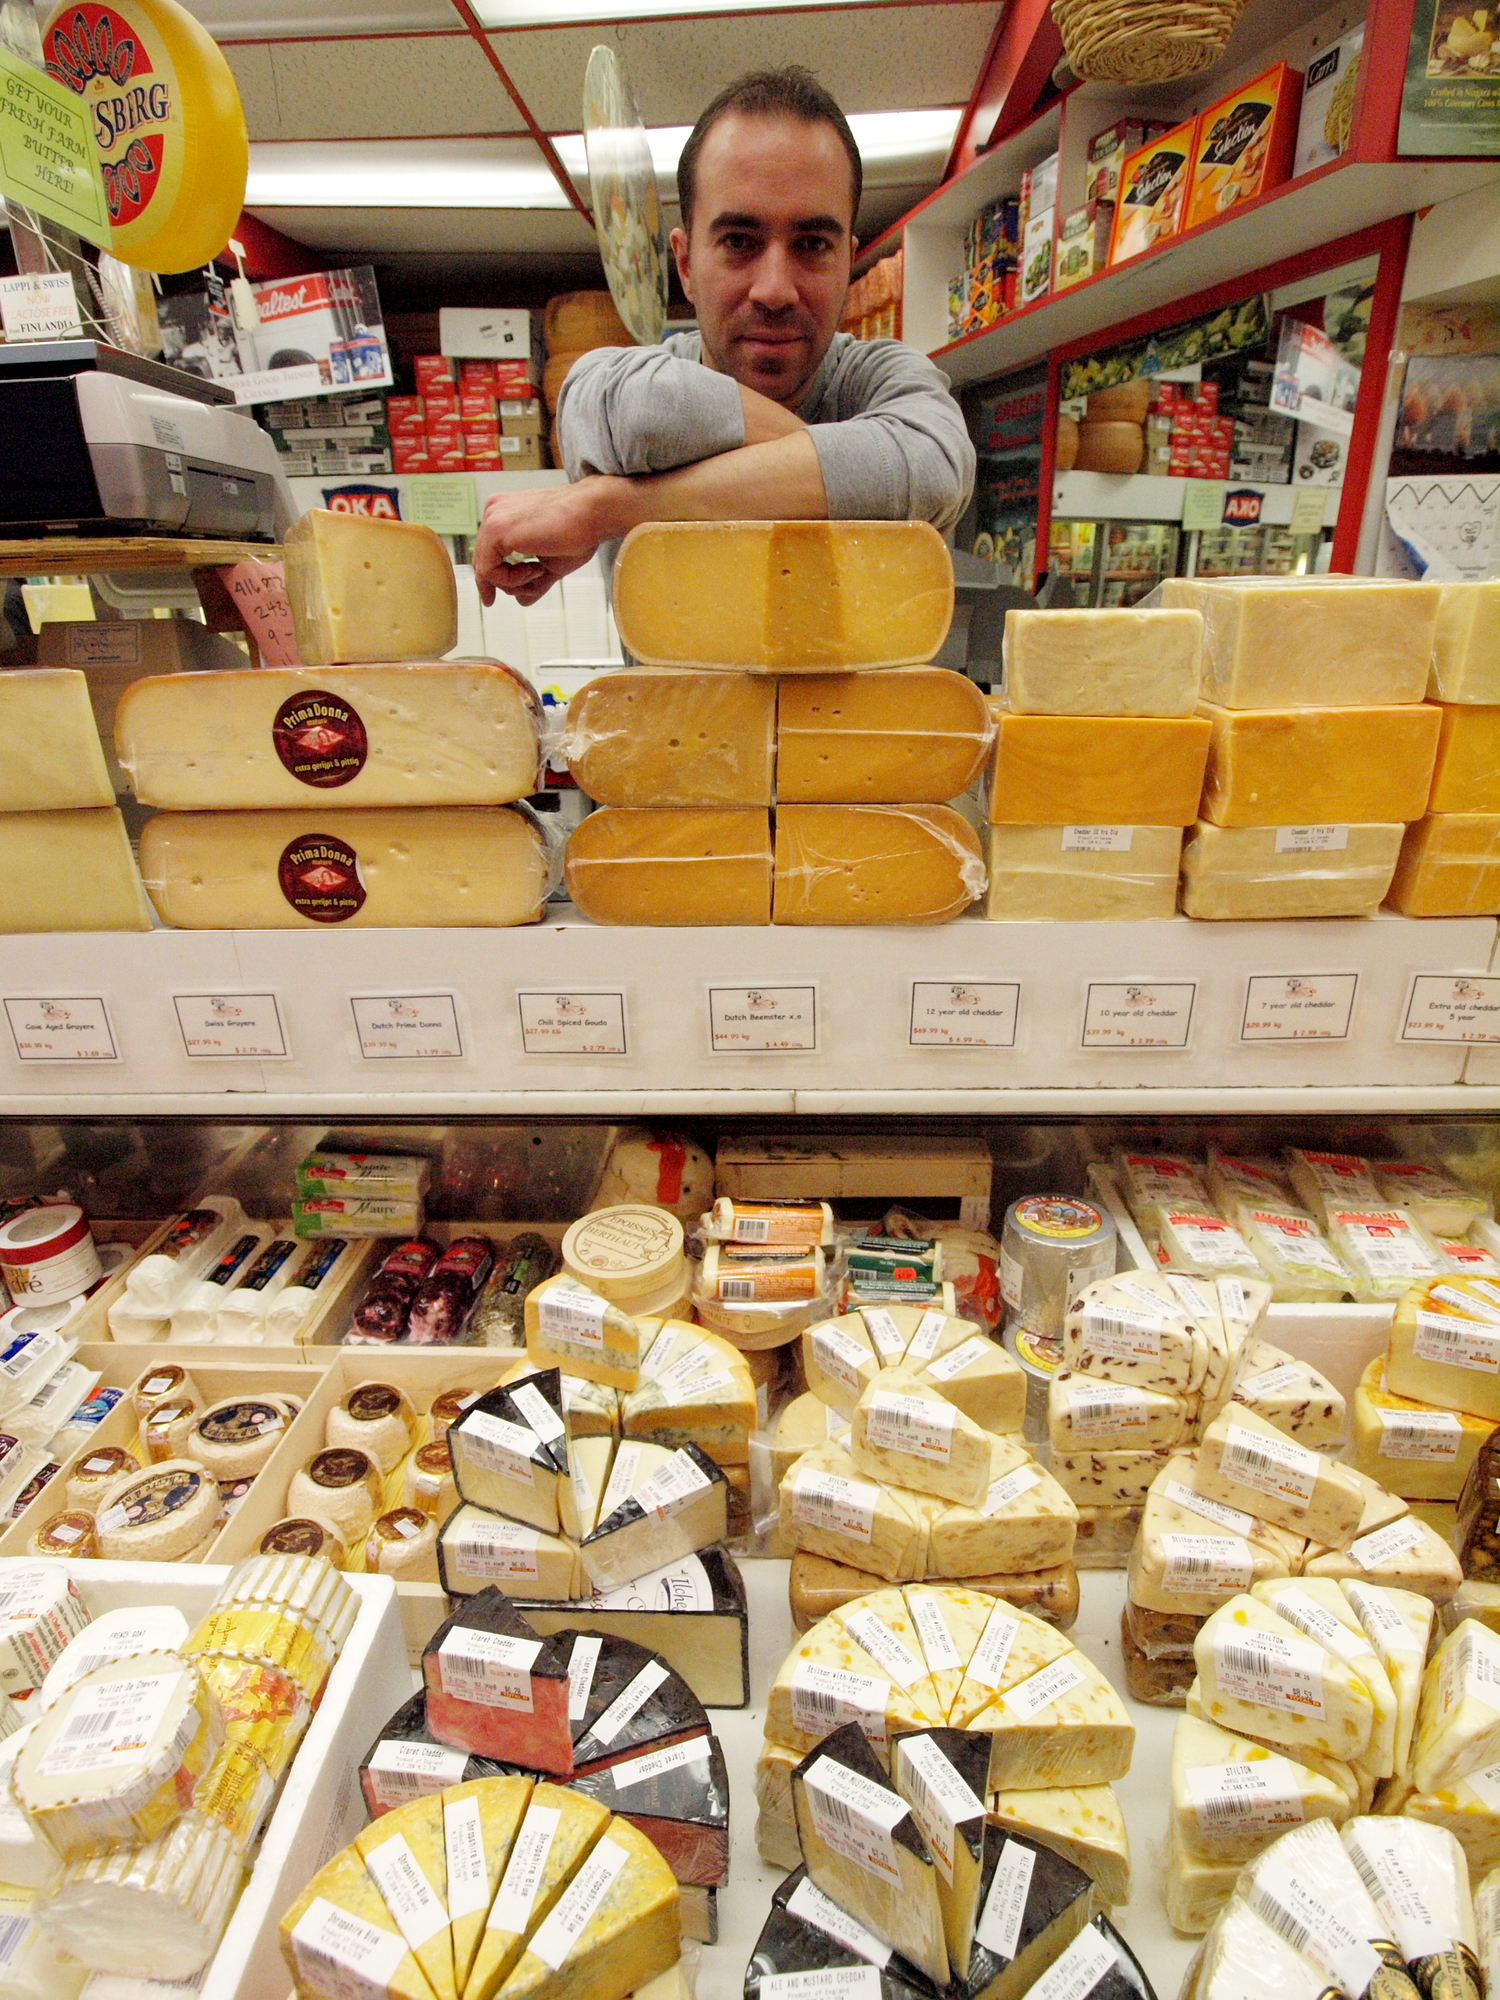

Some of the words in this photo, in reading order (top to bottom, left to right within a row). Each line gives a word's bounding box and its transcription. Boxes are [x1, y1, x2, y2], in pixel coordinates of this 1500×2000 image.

[6, 78, 34, 103] GET
[37, 96, 73, 129] YOUR
[0, 98, 45, 133] FRESH
[49, 126, 87, 158] FARM
[23, 135, 76, 174] BUTTER
[35, 165, 74, 194] HERE!
[3, 282, 31, 292] LAPPI
[33, 281, 41, 290] &
[42, 278, 70, 289] SWISS
[27, 294, 51, 304] NOW
[54, 306, 74, 316] FREE
[332, 497, 395, 516] OKA
[283, 706, 314, 728] Prima
[313, 703, 349, 722] Donna
[295, 764, 311, 772] extra
[334, 759, 340, 767] &
[341, 757, 359, 767] pittig
[290, 849, 320, 865] Prima
[320, 846, 353, 867] Donna
[1429, 1002, 1451, 1010] Extra
[557, 1019, 581, 1027] Spiced
[609, 1215, 659, 1236] EPOISSES
[585, 1226, 641, 1250] BERTHAUT
[1240, 1429, 1262, 1442] Stilton
[1265, 1438, 1280, 1449] with
[1281, 1443, 1307, 1459] Cherries
[1171, 1536, 1193, 1544] Stilton
[1210, 1538, 1235, 1546] Cherries
[110, 1630, 130, 1639] FRENCH
[471, 1632, 490, 1644] Claret
[492, 1637, 516, 1648] Cheddar
[866, 1616, 884, 1634] Stilton
[882, 1634, 895, 1646] with
[894, 1645, 912, 1665] Apricot
[1257, 1632, 1284, 1645] STILTON
[581, 1656, 593, 1674] Claret
[136, 1680, 159, 1690] Chevre
[806, 1665, 830, 1676] Stilton
[832, 1672, 847, 1681] with
[849, 1675, 873, 1687] Apricot
[577, 1676, 588, 1698] Cheddar
[400, 1745, 420, 1755] Claret
[422, 1748, 445, 1758] Cheddar
[923, 1742, 933, 1754] ALE
[931, 1751, 941, 1764] AND
[937, 1760, 961, 1785] MUSTARD
[957, 1782, 978, 1809] CHEDDAR
[1225, 1766, 1253, 1776] STILTON
[208, 1765, 237, 1811] HUMIDITE
[824, 1762, 837, 1774] ALE
[837, 1768, 850, 1781] AND
[848, 1774, 875, 1794] MUSTARD
[873, 1788, 902, 1810] CHEDDAR
[466, 1819, 478, 1859] Shropshire
[529, 1832, 549, 1876] Shropshire
[1020, 1855, 1030, 1869] ALE
[471, 1859, 481, 1879] Blue
[1016, 1869, 1027, 1882] AND
[520, 1877, 535, 1898] Blue
[580, 1868, 612, 1913] Shropshire
[1010, 1883, 1024, 1912] MUSTARD
[1385, 1848, 1399, 1867] Brie
[1397, 1869, 1412, 1889] with
[1410, 1891, 1432, 1926] Truffle
[566, 1912, 584, 1933] Blue
[1289, 1878, 1307, 1899] Brie
[1308, 1898, 1326, 1916] with
[1327, 1914, 1357, 1946] Truffle
[327, 1911, 364, 1937] Shropshire
[363, 1929, 380, 1945] Blue
[1003, 1913, 1018, 1944] CHEDDAR
[1443, 1950, 1460, 1975] RIE
[770, 1980, 782, 1991] ALE
[787, 1978, 799, 1988] AND
[803, 1973, 832, 1987] MUSTARD
[836, 1970, 867, 1981] CHEDDAR
